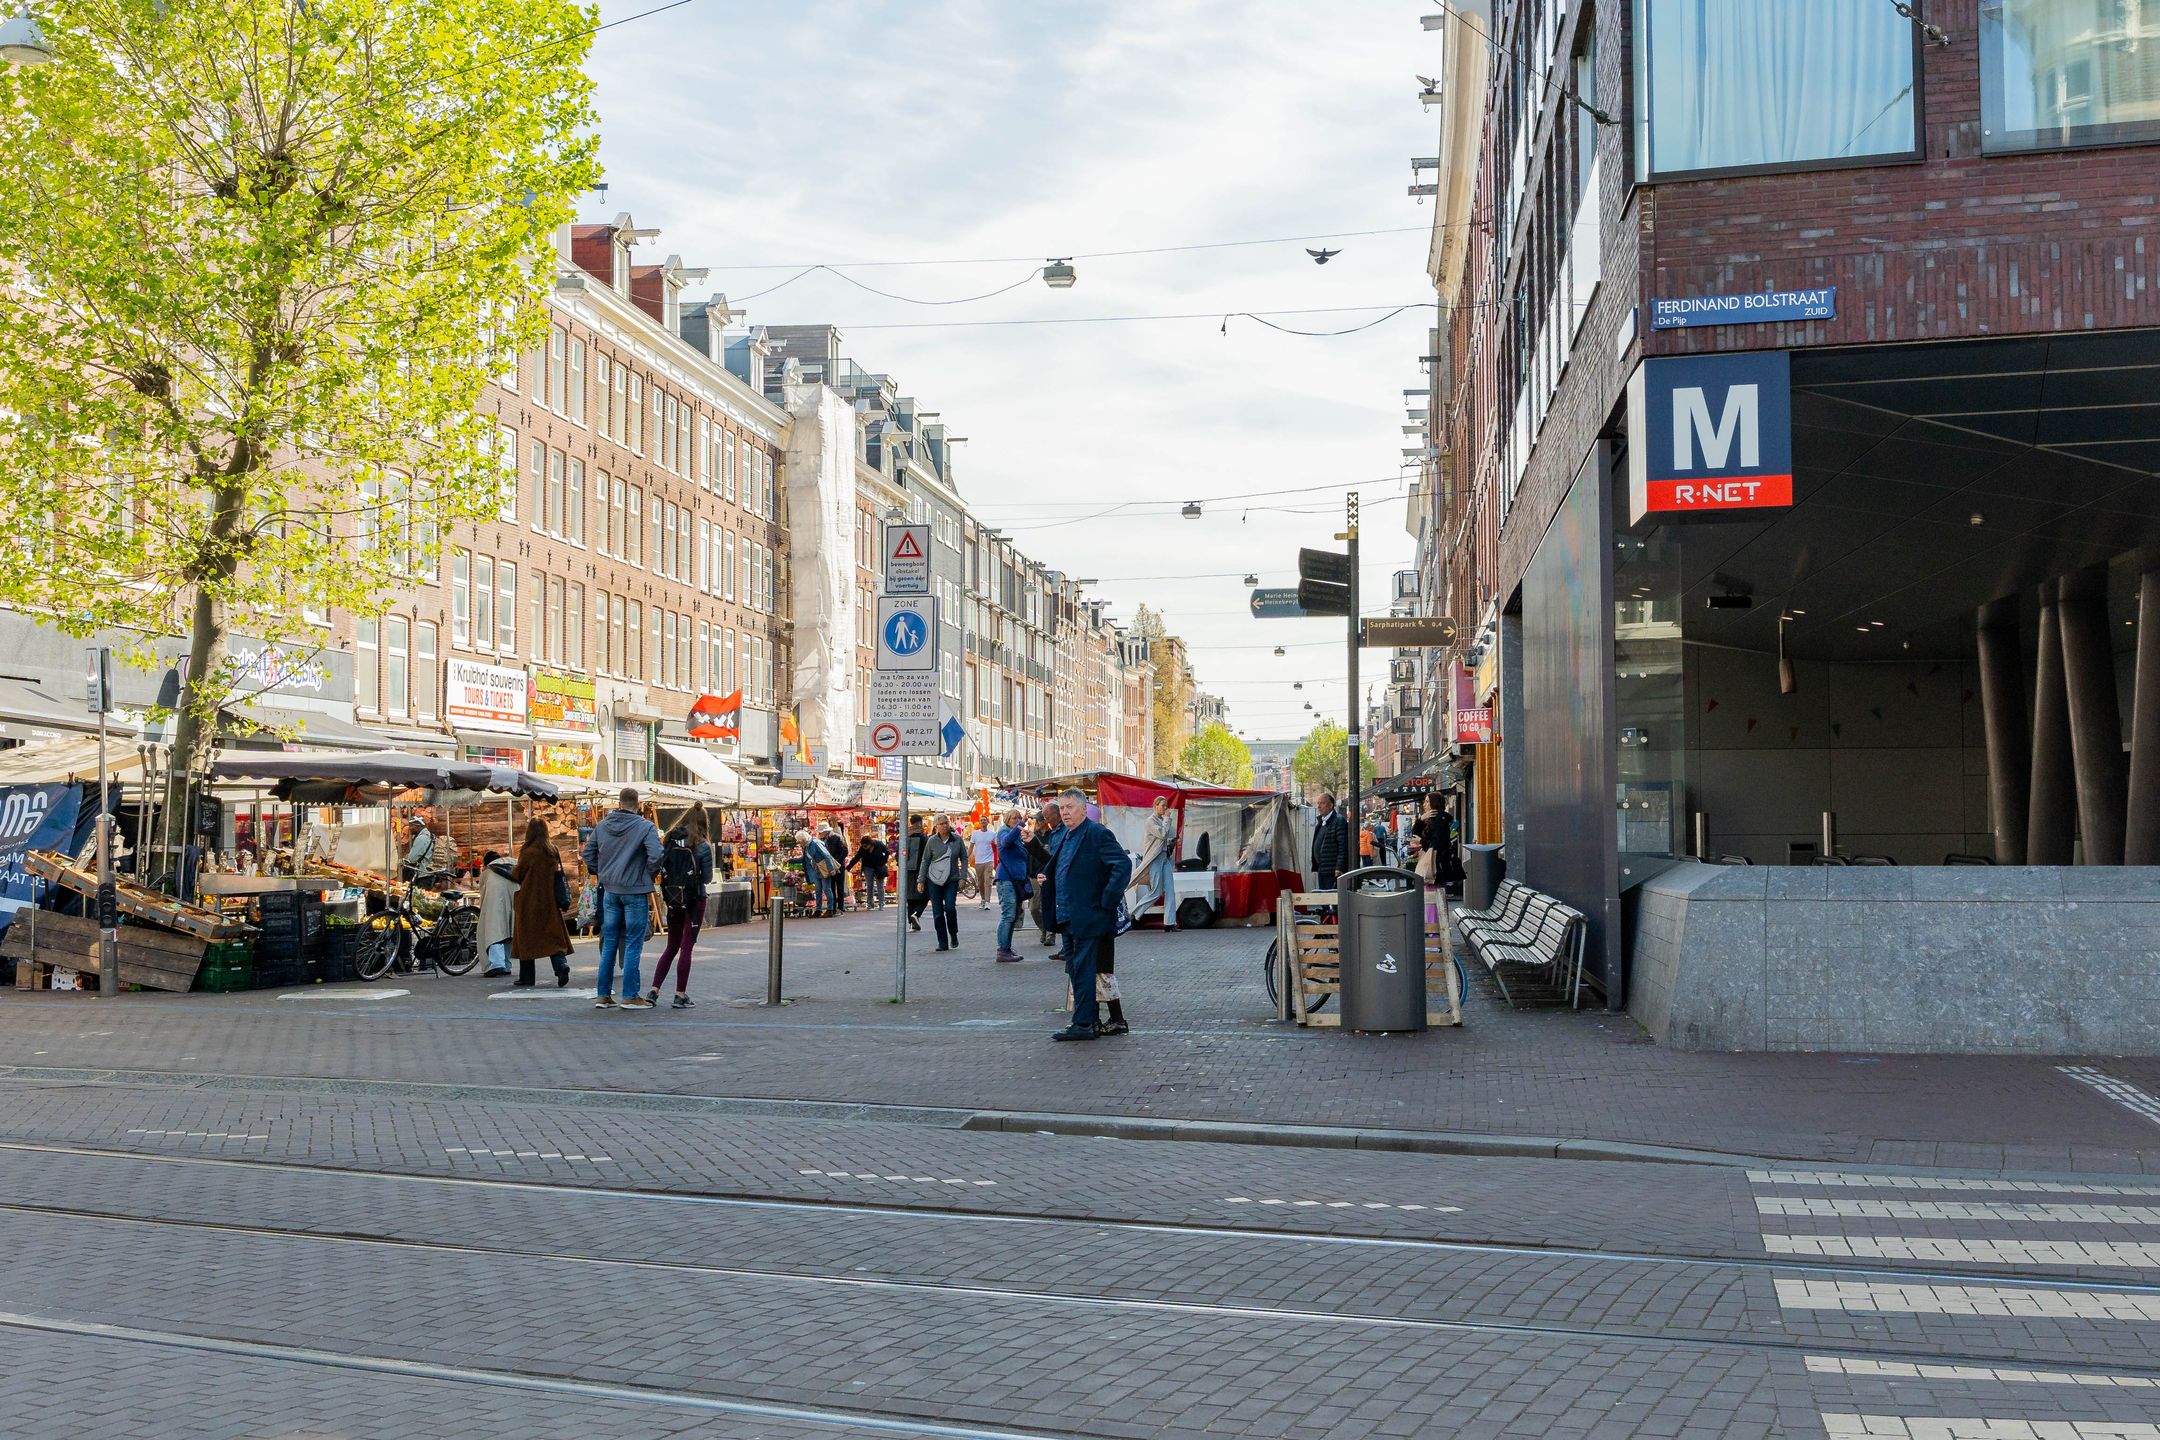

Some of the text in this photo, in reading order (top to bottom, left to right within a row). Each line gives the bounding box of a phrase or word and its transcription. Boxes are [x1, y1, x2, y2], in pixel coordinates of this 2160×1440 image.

[1658, 291, 1828, 314] FERDINAND BOLSTRAAT
[1804, 307, 1828, 316] ZUID
[1658, 316, 1687, 326] De Pijp
[1672, 384, 1760, 470] M
[894, 600, 919, 608] ZONE
[1369, 621, 1416, 629] Sarphatipark
[457, 663, 489, 686] Kruithof
[490, 673, 525, 692] souvenirs
[464, 686, 484, 706] TOURS
[485, 689, 489, 706] &
[490, 690, 514, 710] TICKETS
[1458, 710, 1489, 722] COFFEE
[1459, 722, 1479, 732] TO GO
[0, 869, 29, 886] AAT
